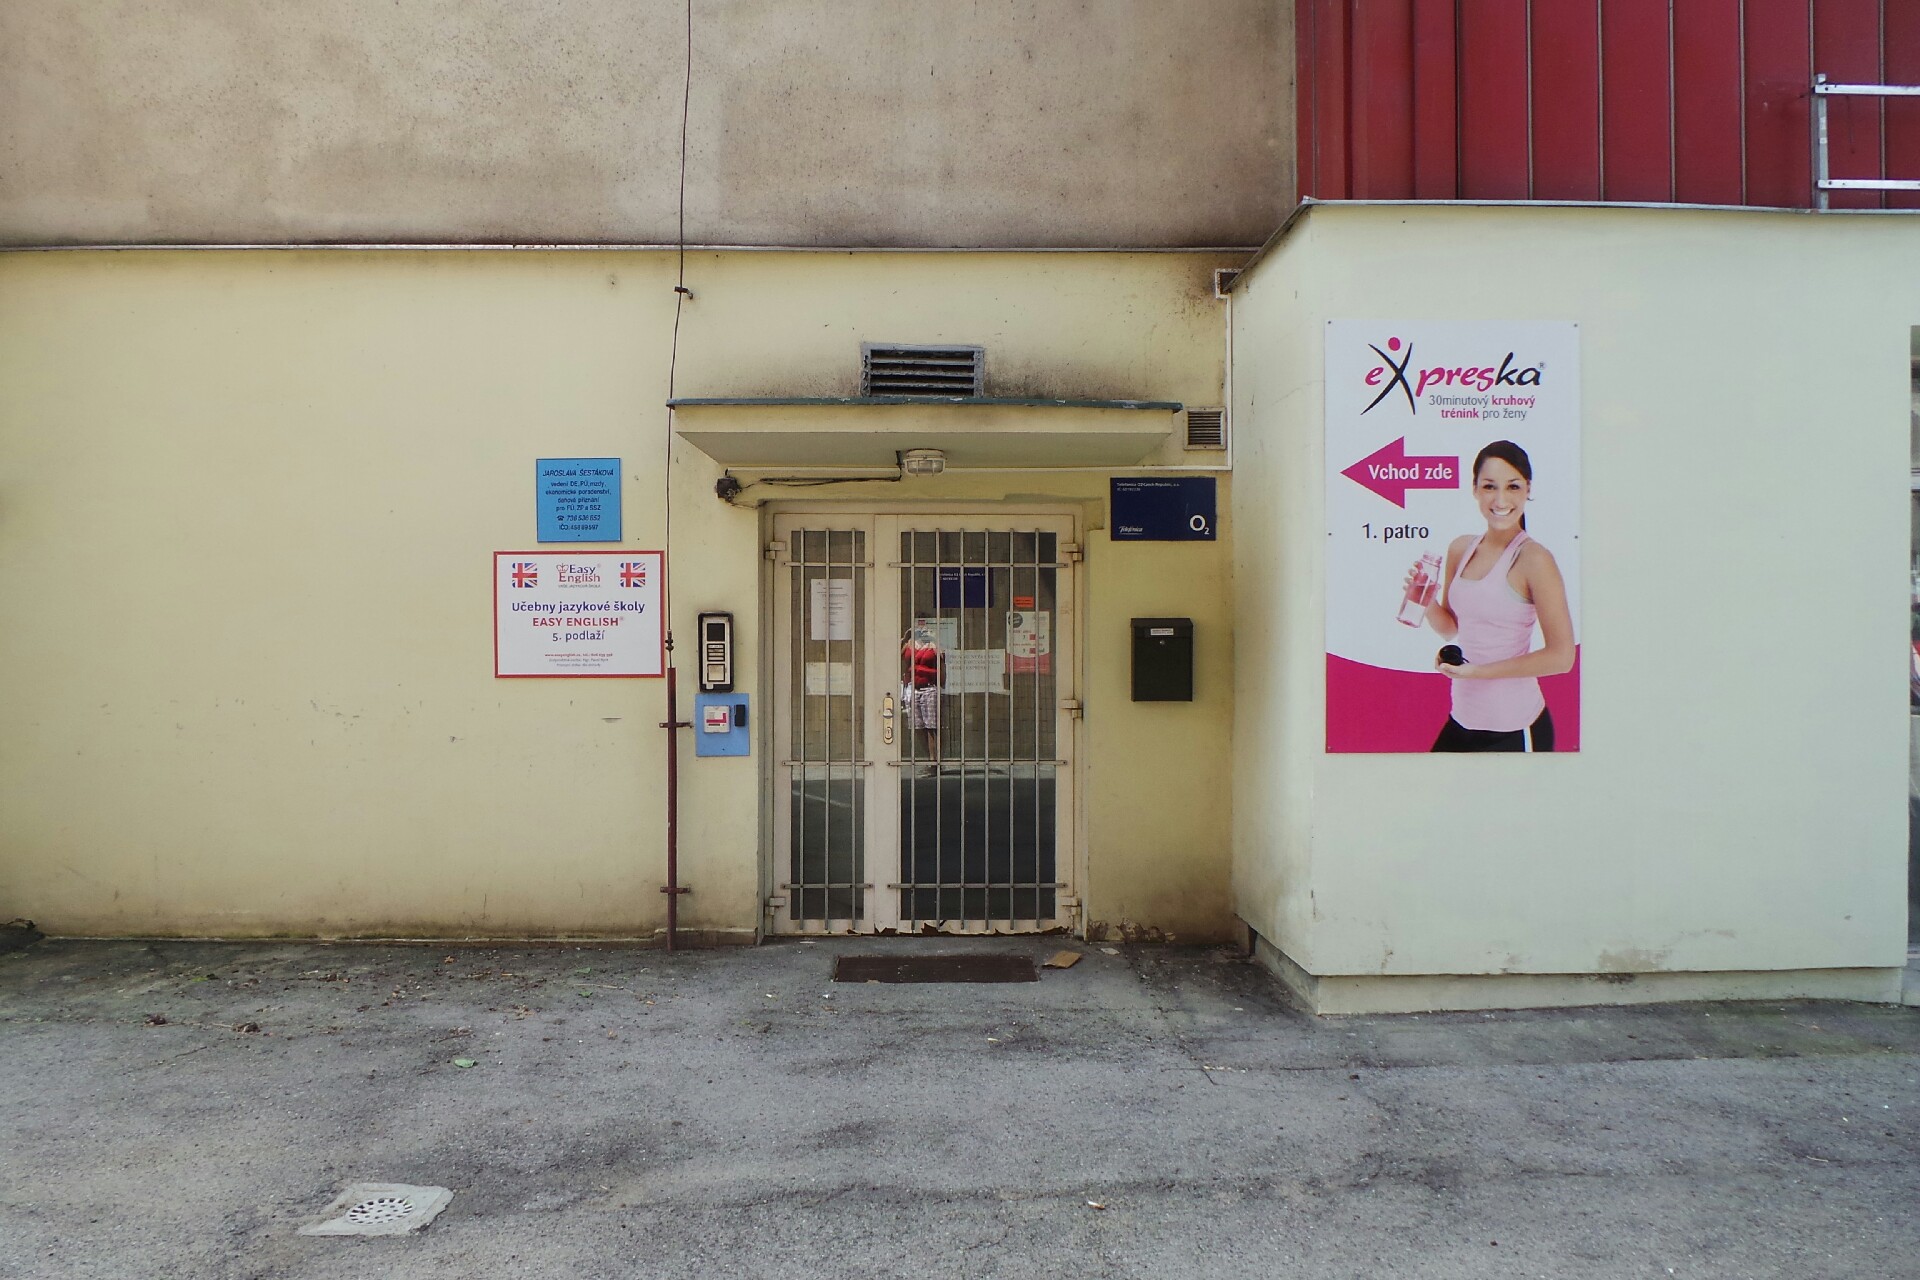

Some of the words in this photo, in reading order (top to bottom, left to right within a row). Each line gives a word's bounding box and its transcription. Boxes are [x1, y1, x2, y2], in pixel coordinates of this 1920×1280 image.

[1429, 394, 1488, 408] 30minutový
[1491, 394, 1536, 408] kruhový
[1441, 408, 1479, 419] trénink
[1482, 410, 1500, 421] pro
[1503, 408, 1527, 421] ženy
[543, 469, 577, 477] JAROSLAVA
[1368, 463, 1419, 480] Vchod
[1424, 463, 1452, 480] zde
[1362, 523, 1377, 539] 1.
[1383, 525, 1429, 543] patro
[569, 564, 596, 575] Easy
[558, 572, 601, 584] English
[512, 601, 556, 614] Učebny
[558, 601, 610, 615] jazykové
[613, 600, 645, 614] školy
[532, 617, 563, 627] EASY
[552, 632, 562, 642] 5.
[565, 630, 605, 643] podlaží
